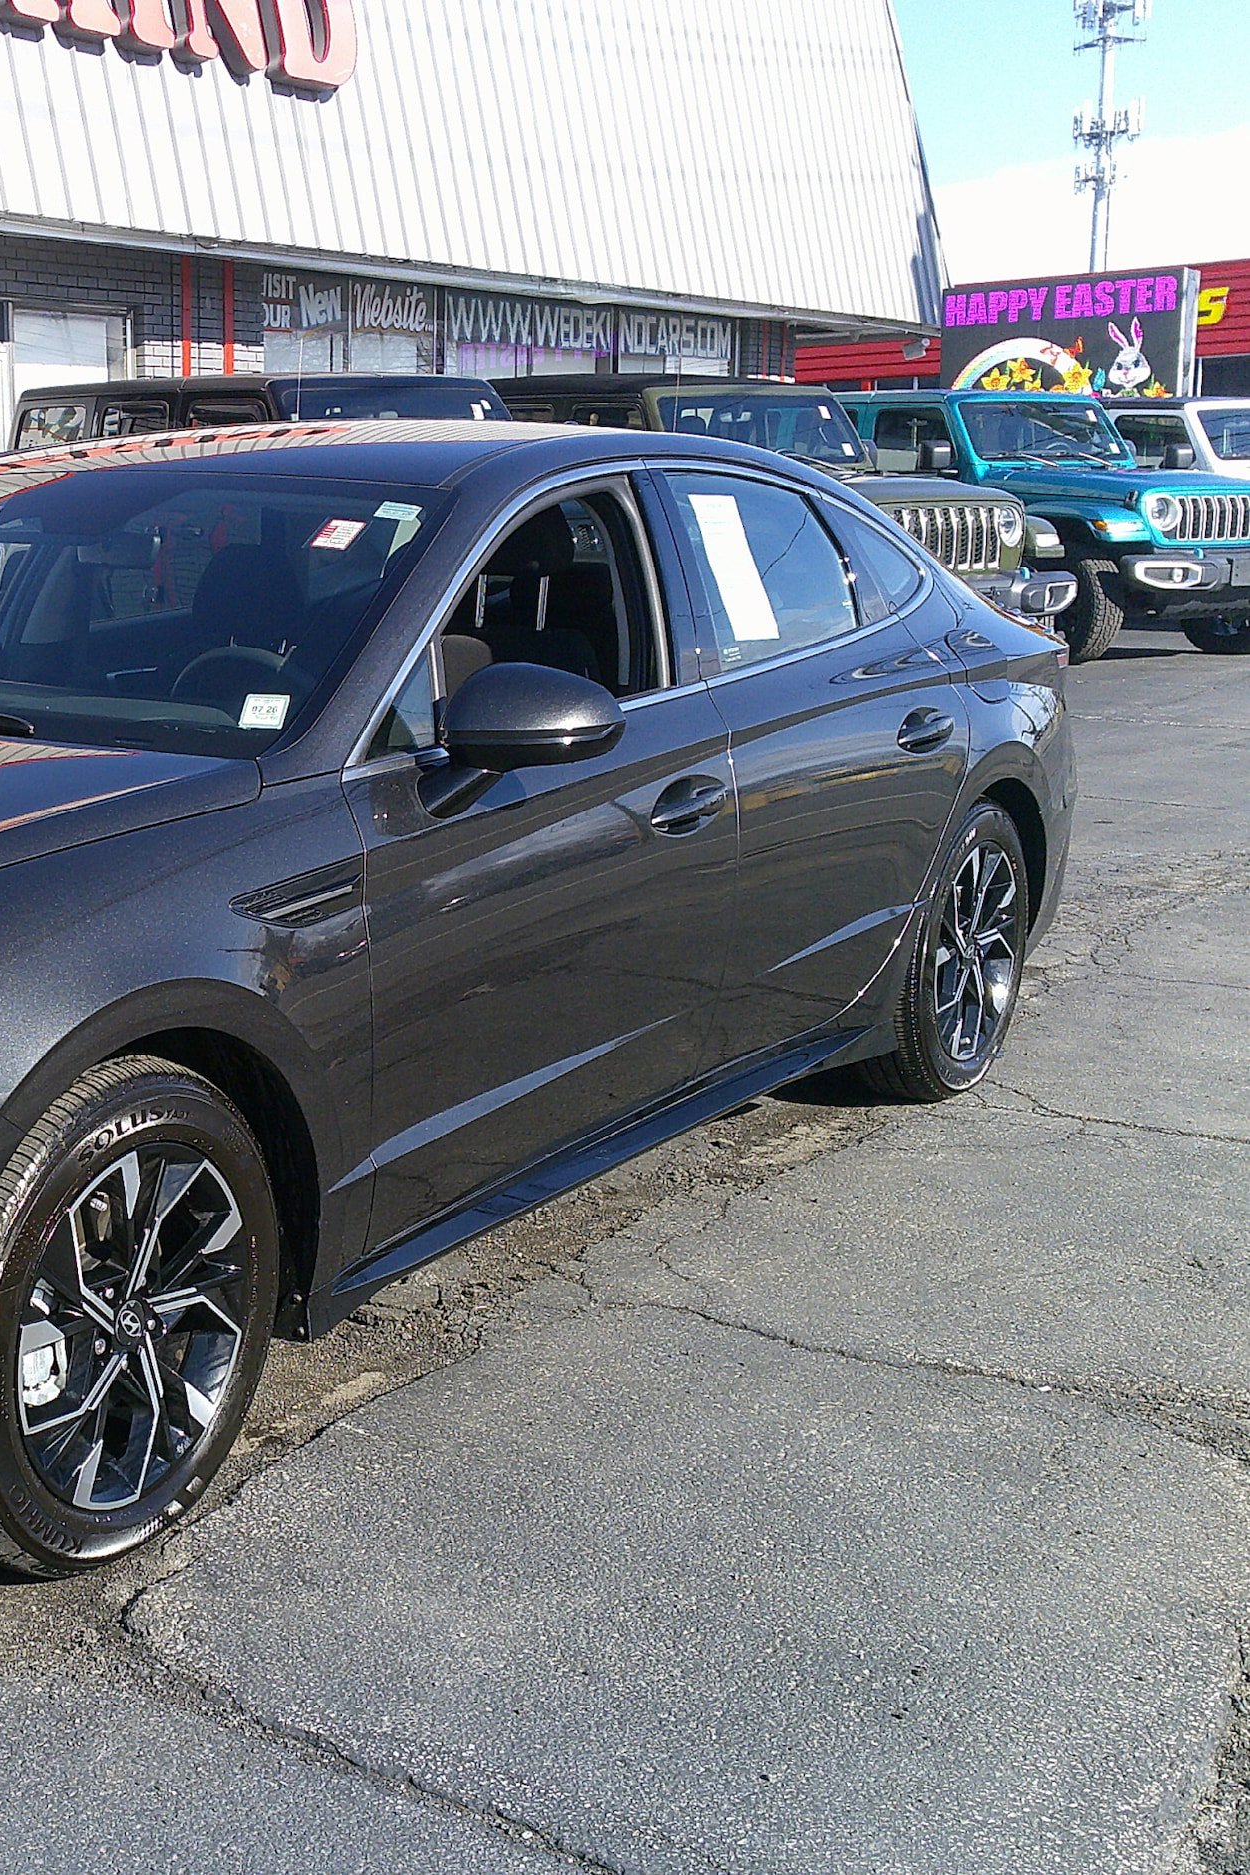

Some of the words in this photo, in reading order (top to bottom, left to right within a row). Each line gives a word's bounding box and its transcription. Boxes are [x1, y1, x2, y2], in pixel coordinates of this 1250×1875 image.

[298, 283, 342, 328] New
[945, 286, 1049, 327] HAPPY
[1054, 275, 1179, 320] EASTER
[77, 1104, 166, 1168] SOLUS
